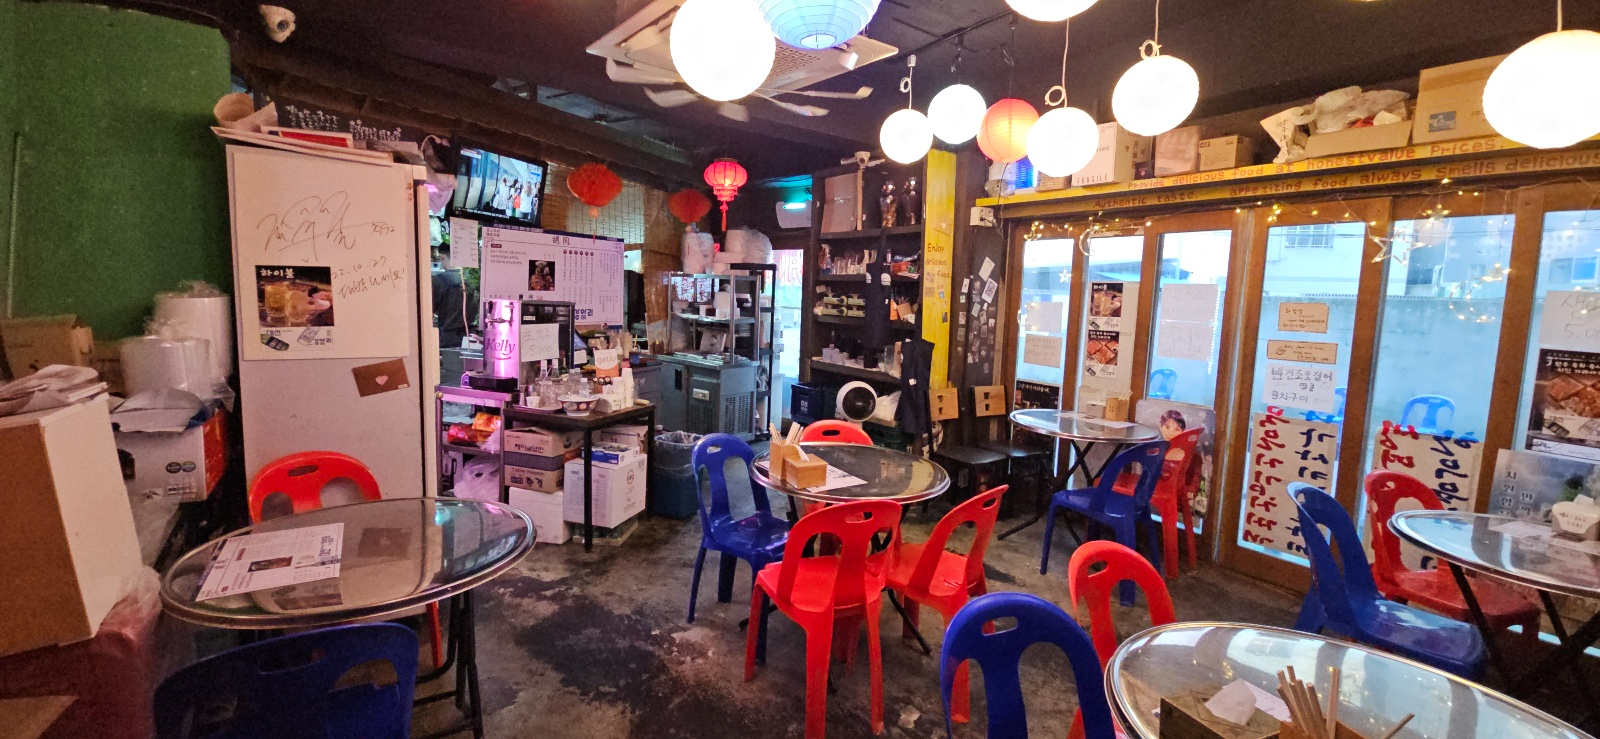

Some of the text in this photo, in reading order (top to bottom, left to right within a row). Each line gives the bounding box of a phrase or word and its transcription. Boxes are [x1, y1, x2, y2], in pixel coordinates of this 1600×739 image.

[1077, 173, 1108, 184] FRAGILE
[1128, 179, 1165, 190] Provide
[1172, 171, 1224, 185] delicious
[1233, 167, 1264, 180] food
[1275, 162, 1294, 173] at
[1093, 197, 1146, 209] Authentic
[1229, 181, 1302, 197] appetizing
[1359, 169, 1422, 185] always
[259, 268, 295, 279] 하이볼
[486, 338, 516, 356] Kelly
